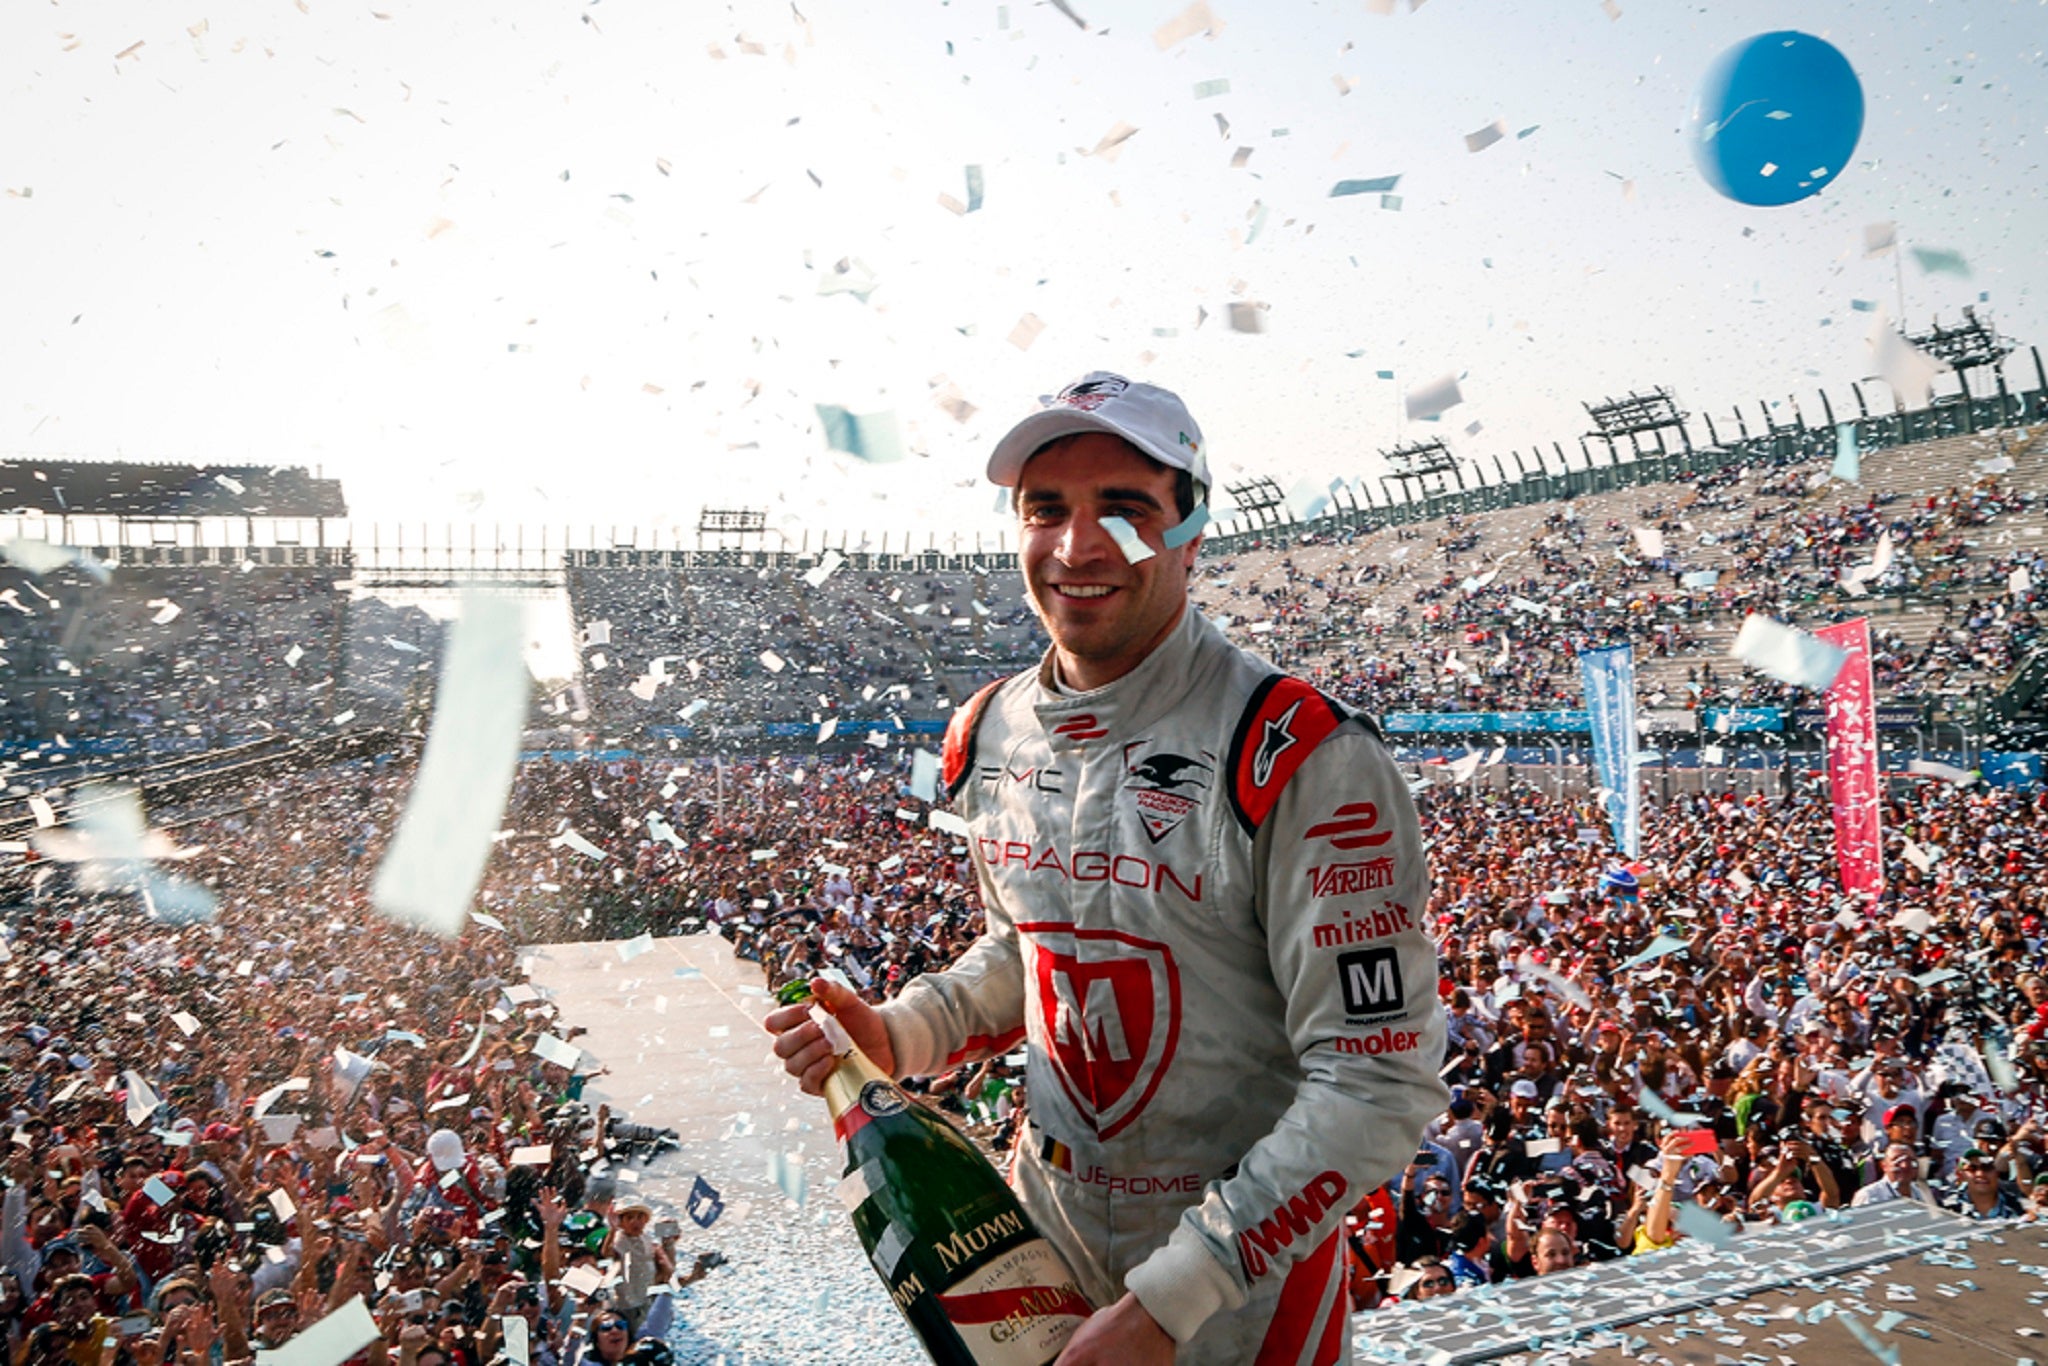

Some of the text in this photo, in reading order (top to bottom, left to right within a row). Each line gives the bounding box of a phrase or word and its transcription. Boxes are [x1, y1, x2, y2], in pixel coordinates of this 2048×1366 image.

[978, 837, 1202, 902] DRAGON
[1306, 856, 1395, 898] VARIETY
[1313, 901, 1413, 948] mixbit
[1348, 958, 1397, 1006] M
[1051, 969, 1131, 1062] M
[1335, 1027, 1421, 1055] molex
[1077, 1165, 1200, 1195] JEROME
[932, 1209, 1024, 1274] MUMM
